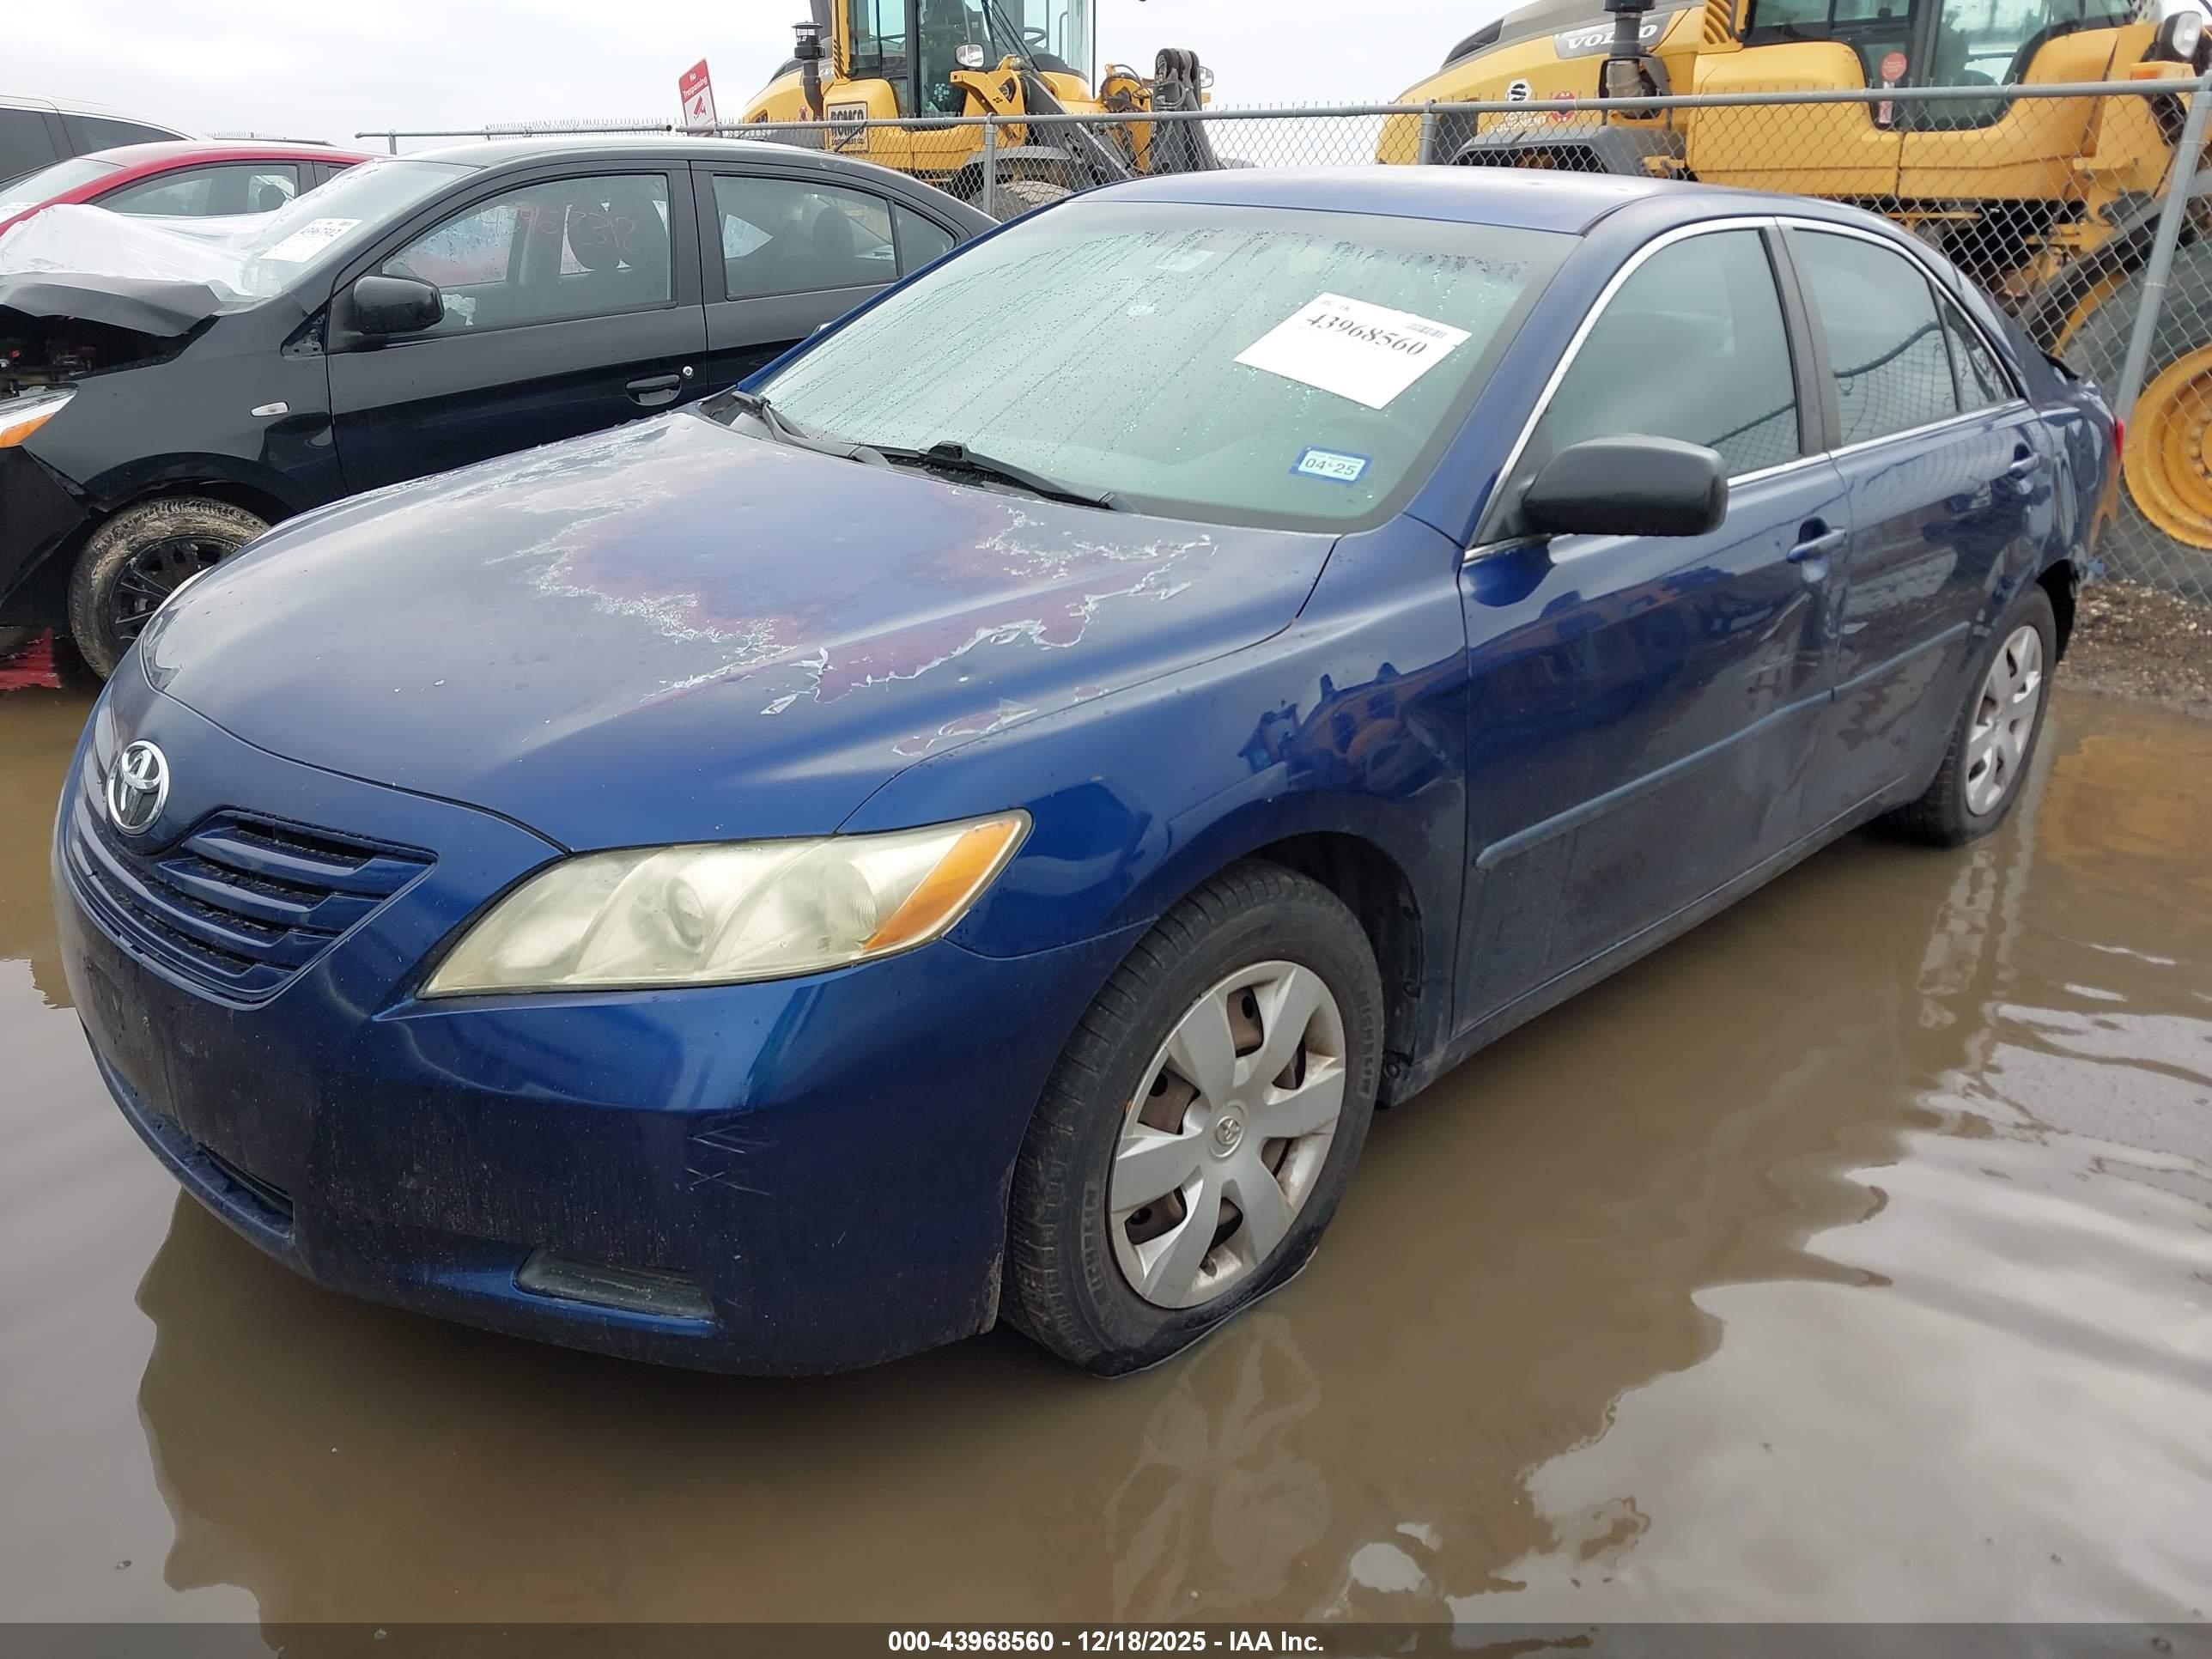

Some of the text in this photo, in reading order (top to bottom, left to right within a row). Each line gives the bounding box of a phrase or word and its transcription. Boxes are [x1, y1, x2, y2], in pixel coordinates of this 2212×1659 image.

[1566, 25, 1657, 49] VOLO
[683, 76, 708, 99] Trespassing
[690, 72, 696, 83] No
[1307, 313, 1428, 356] 43968560
[1305, 458, 1327, 471] 04
[1333, 463, 1358, 476] 25
